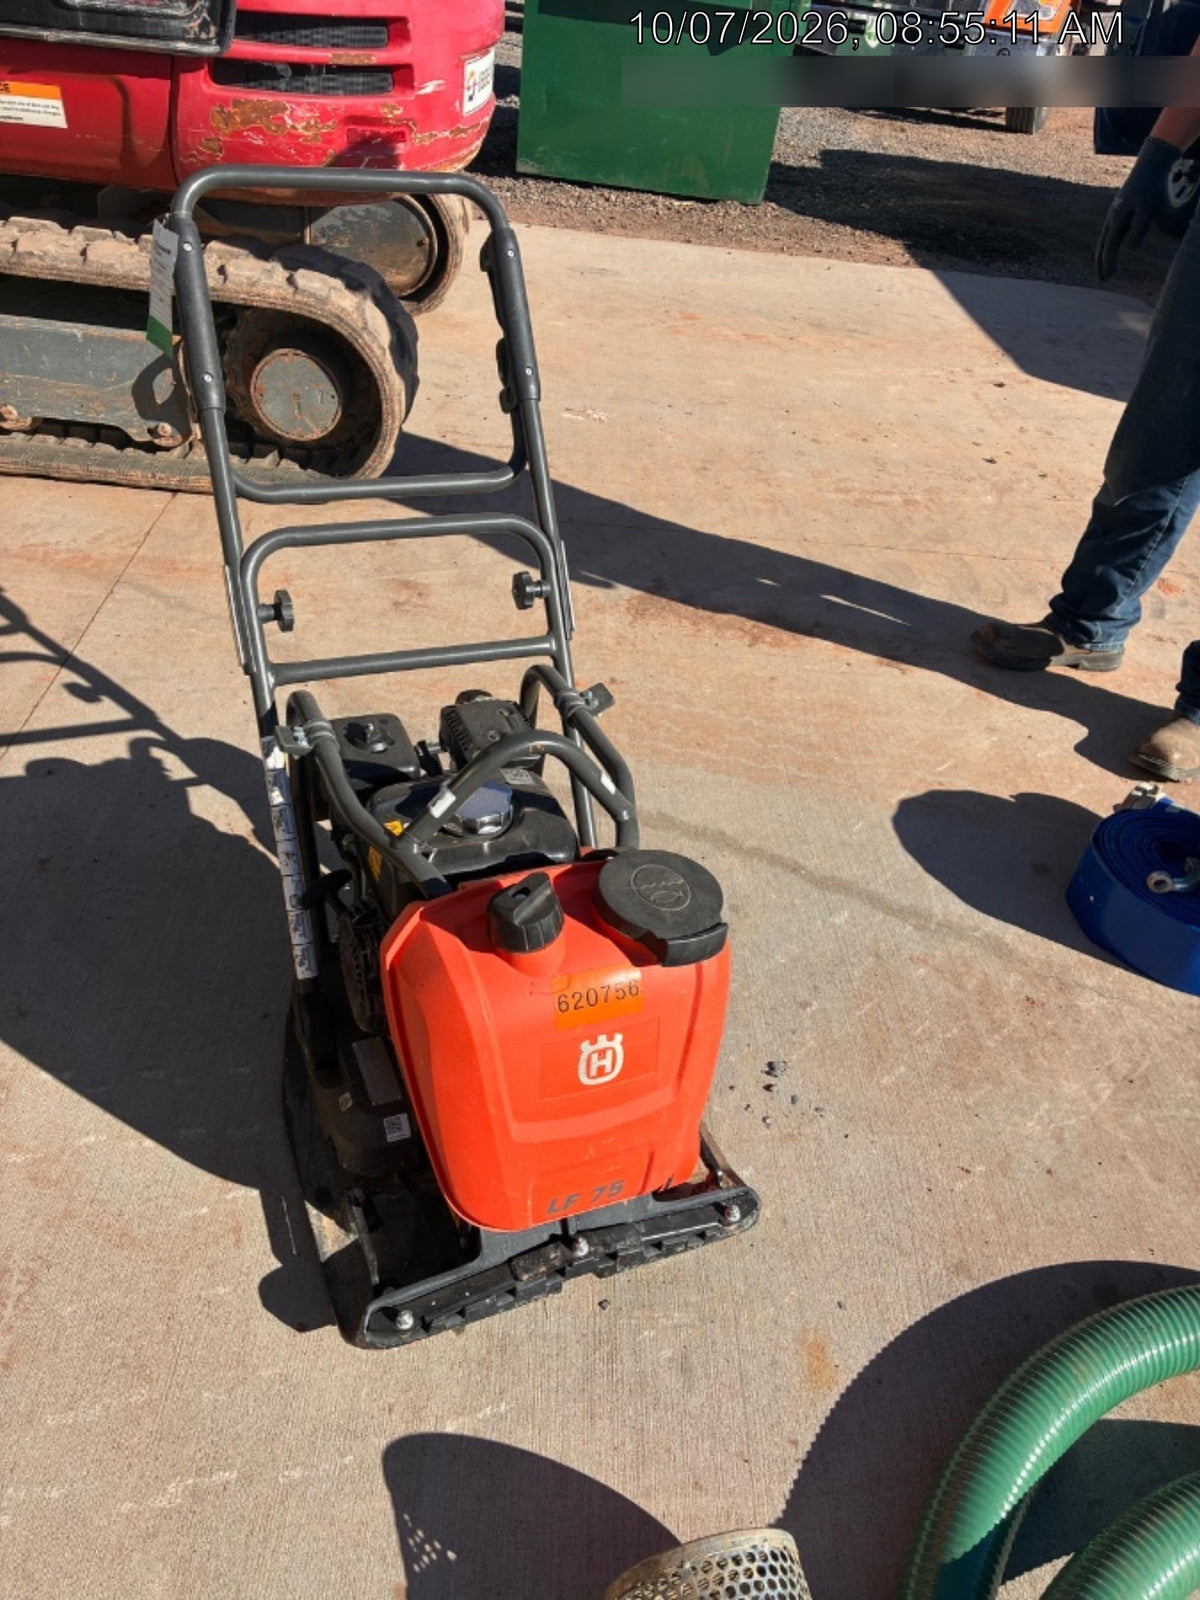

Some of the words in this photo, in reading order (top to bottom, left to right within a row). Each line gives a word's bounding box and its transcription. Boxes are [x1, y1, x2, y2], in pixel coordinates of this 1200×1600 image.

[557, 979, 639, 1013] 620756
[547, 1192, 582, 1214] LF
[590, 1180, 625, 1203] 75
